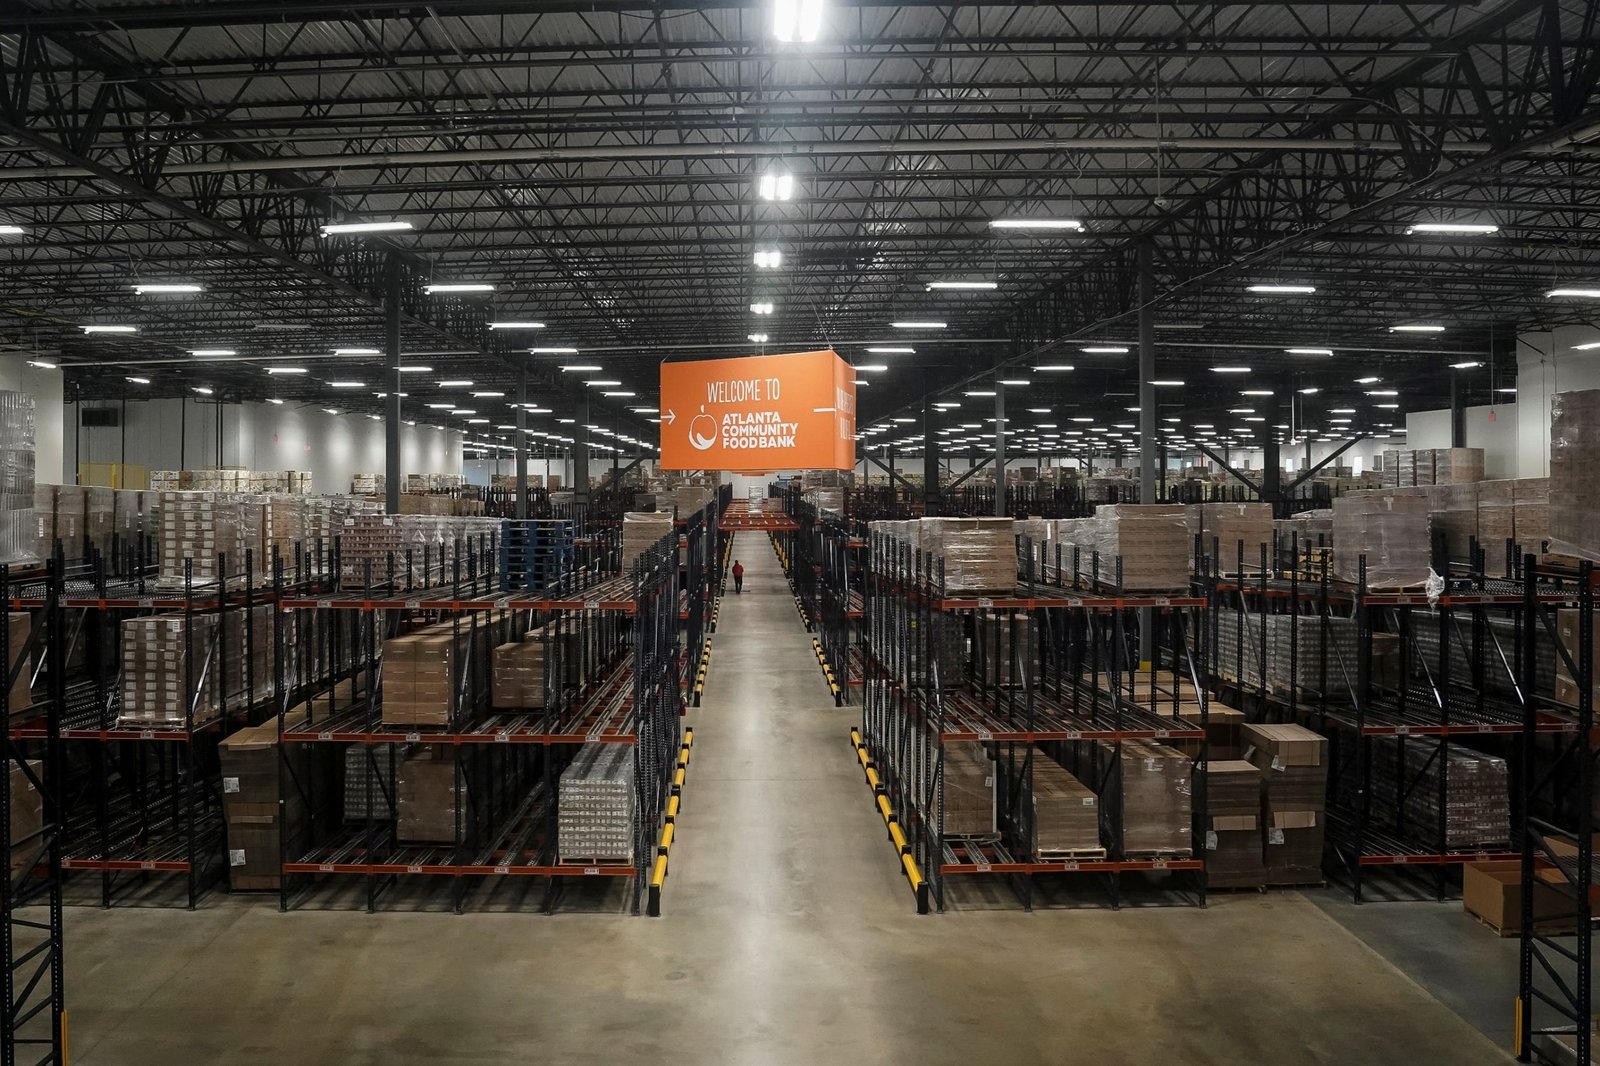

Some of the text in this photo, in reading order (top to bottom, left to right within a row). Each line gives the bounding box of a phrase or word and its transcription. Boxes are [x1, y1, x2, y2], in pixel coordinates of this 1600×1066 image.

[707, 378, 781, 403] WELCOME TO
[722, 411, 781, 425] ATLANTA
[722, 422, 799, 437] COMMUNITY
